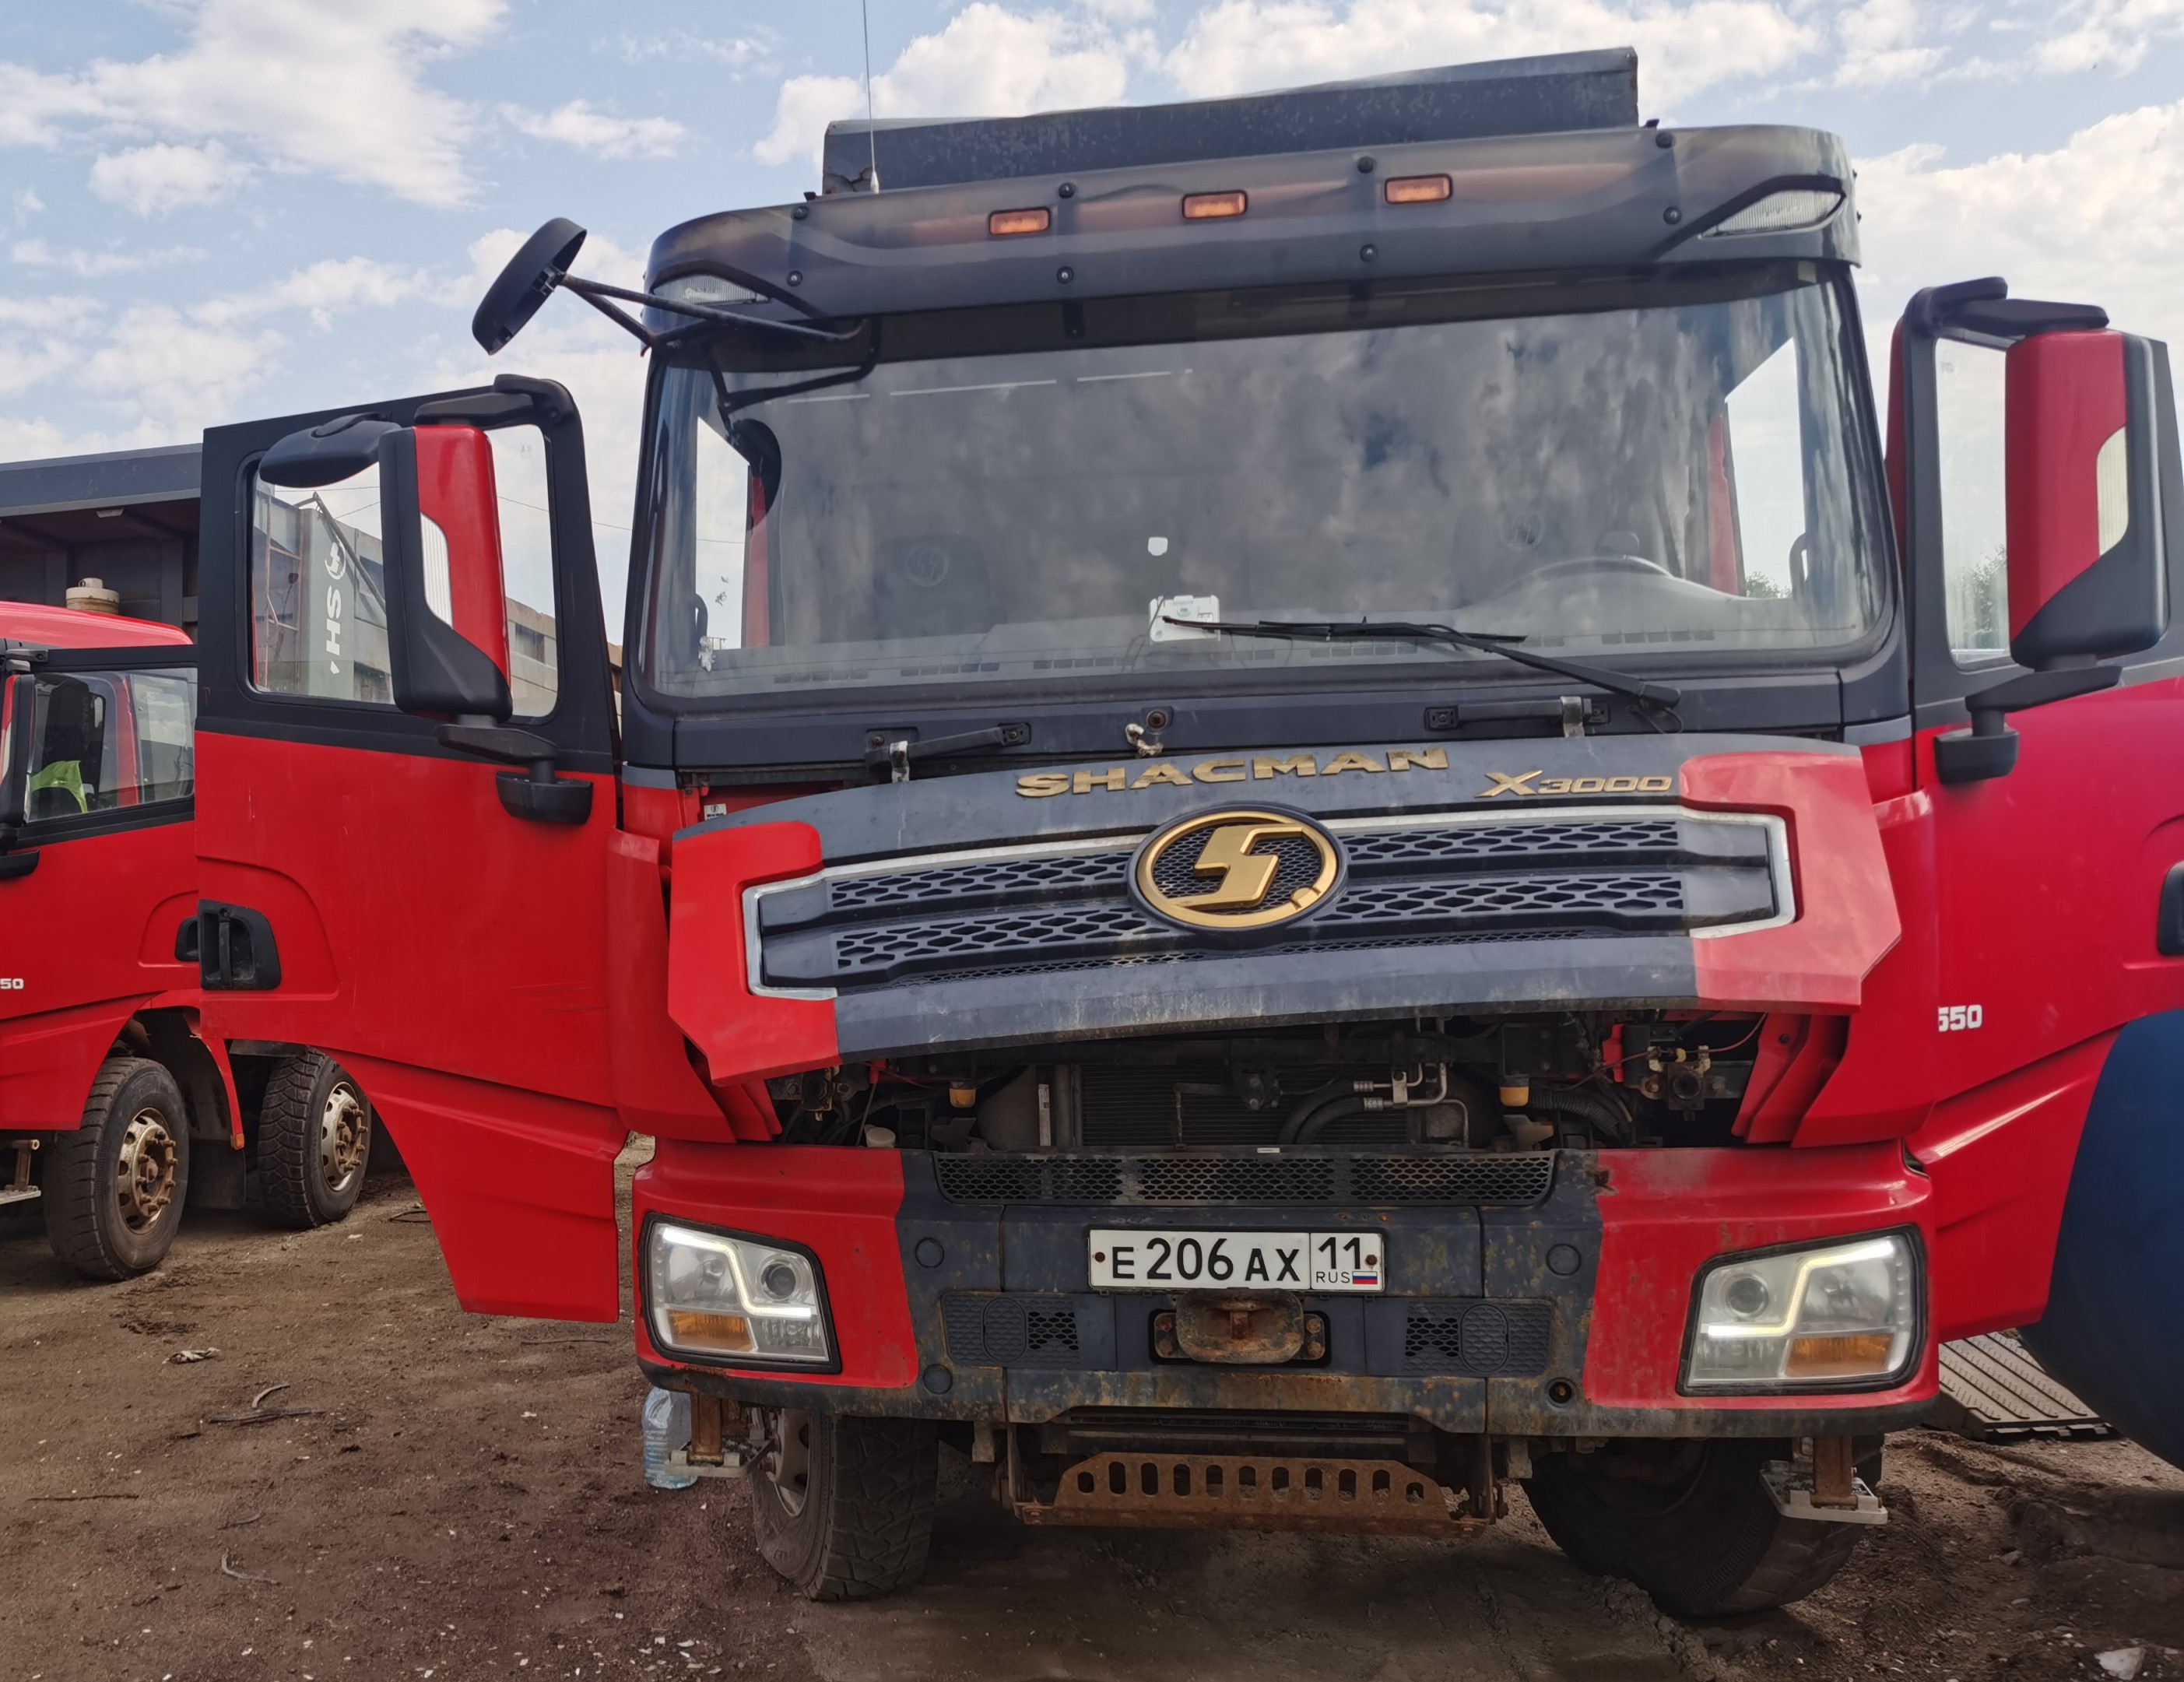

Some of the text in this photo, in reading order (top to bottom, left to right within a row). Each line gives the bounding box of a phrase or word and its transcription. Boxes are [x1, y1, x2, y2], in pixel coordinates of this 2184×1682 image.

[1016, 748, 1448, 797] SHACMAN
[1475, 770, 1672, 798] X3000
[1318, 1236, 1361, 1270] 11
[1315, 1271, 1351, 1284] RUS
